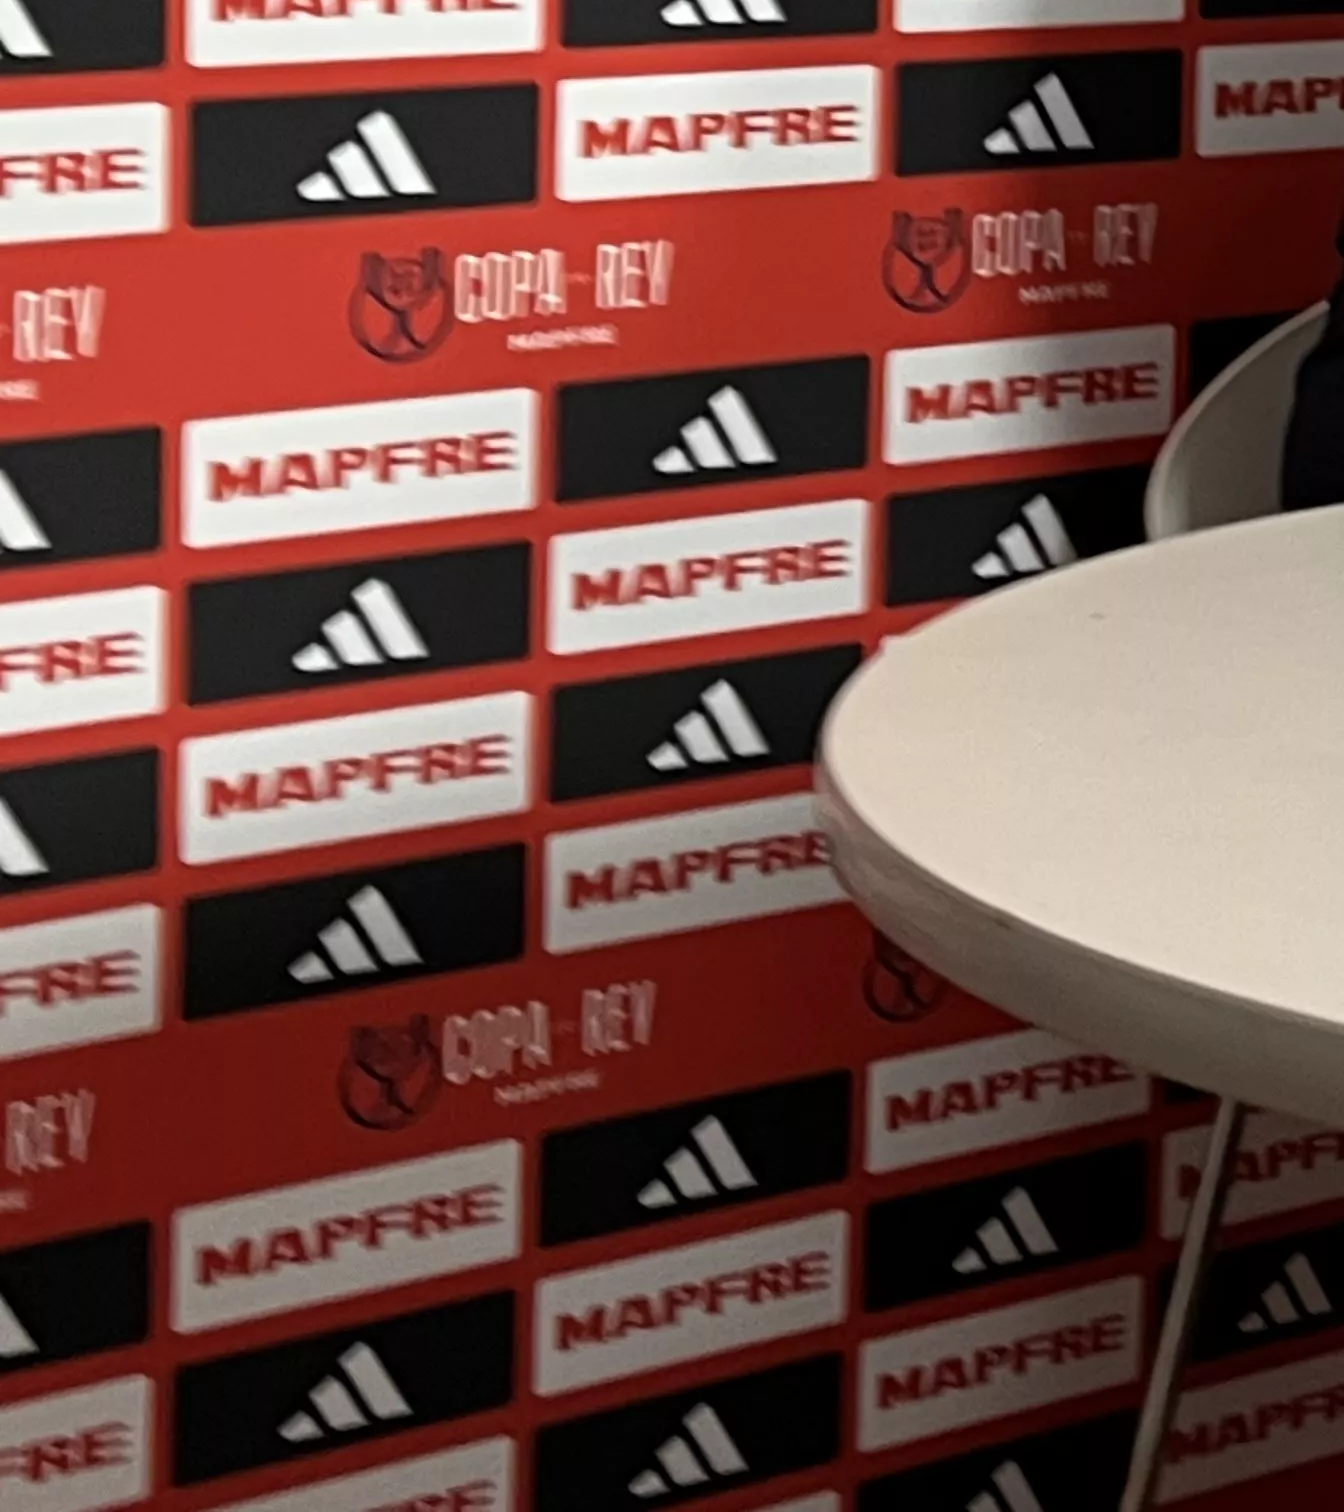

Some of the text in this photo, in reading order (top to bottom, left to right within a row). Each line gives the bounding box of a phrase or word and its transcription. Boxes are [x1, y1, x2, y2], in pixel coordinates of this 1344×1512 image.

[582, 105, 858, 158] MAPFRE
[0, 149, 141, 197] FRE
[971, 203, 1157, 278] COPA REY
[455, 240, 672, 323] COPA REY
[13, 286, 103, 362] REY
[907, 362, 1160, 423] MAPFRE
[210, 432, 514, 501] MAPFRE
[573, 540, 849, 610] MAPFRE
[0, 633, 140, 690] FRE
[206, 735, 512, 819] MAPFRE
[564, 831, 832, 911] MAPFRE
[0, 952, 137, 1014] FRE
[442, 980, 655, 1086] COPA REY
[6, 1089, 94, 1175] REY
[197, 1183, 503, 1287] MAPFRE
[556, 1251, 830, 1352] MAPFRE
[877, 1313, 1128, 1410] MAPFRE
